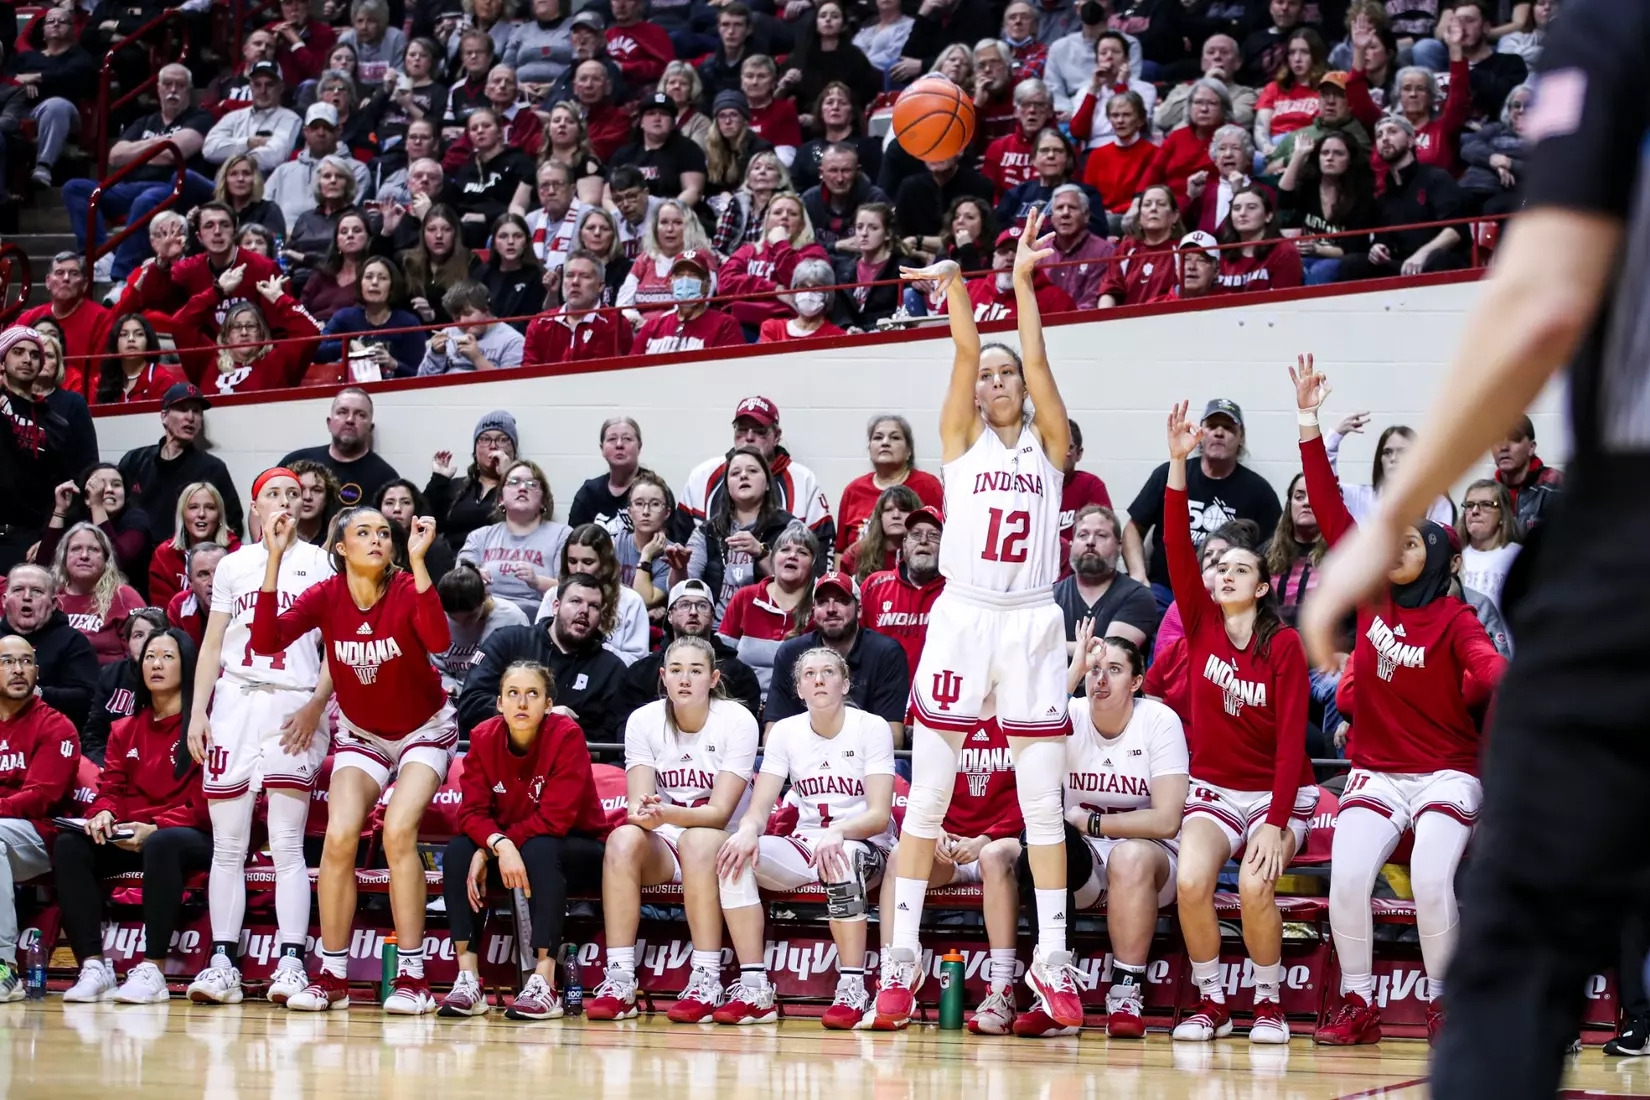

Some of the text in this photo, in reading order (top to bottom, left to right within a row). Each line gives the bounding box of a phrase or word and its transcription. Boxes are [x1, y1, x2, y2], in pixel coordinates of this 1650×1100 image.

[980, 507, 1030, 564] 12
[68, 613, 104, 633] VENS
[333, 636, 403, 666] NDIANA
[1069, 772, 1150, 797] INDIANA
